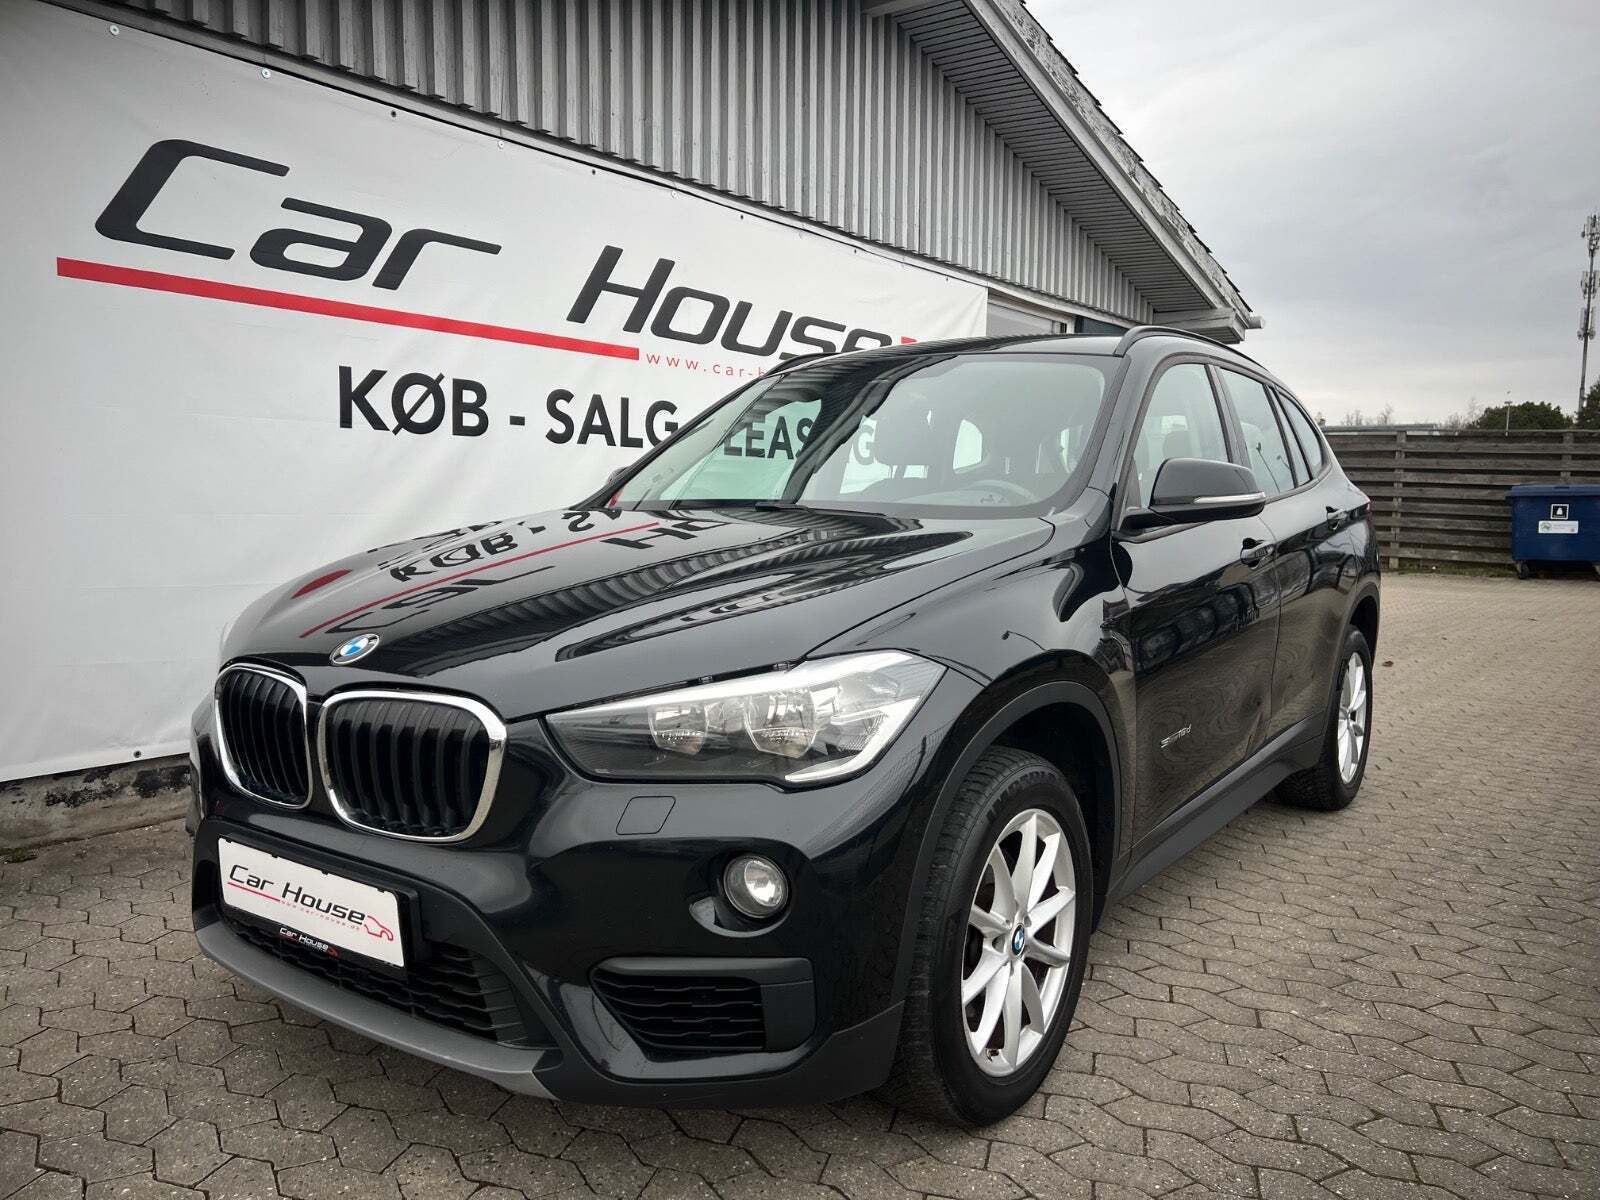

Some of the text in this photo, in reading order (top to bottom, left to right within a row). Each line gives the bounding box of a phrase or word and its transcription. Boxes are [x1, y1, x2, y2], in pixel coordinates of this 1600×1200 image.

[94, 138, 893, 361] Car House
[338, 365, 489, 437] KØB
[545, 388, 679, 450] SALG
[229, 864, 275, 891] Car
[281, 882, 367, 926] House
